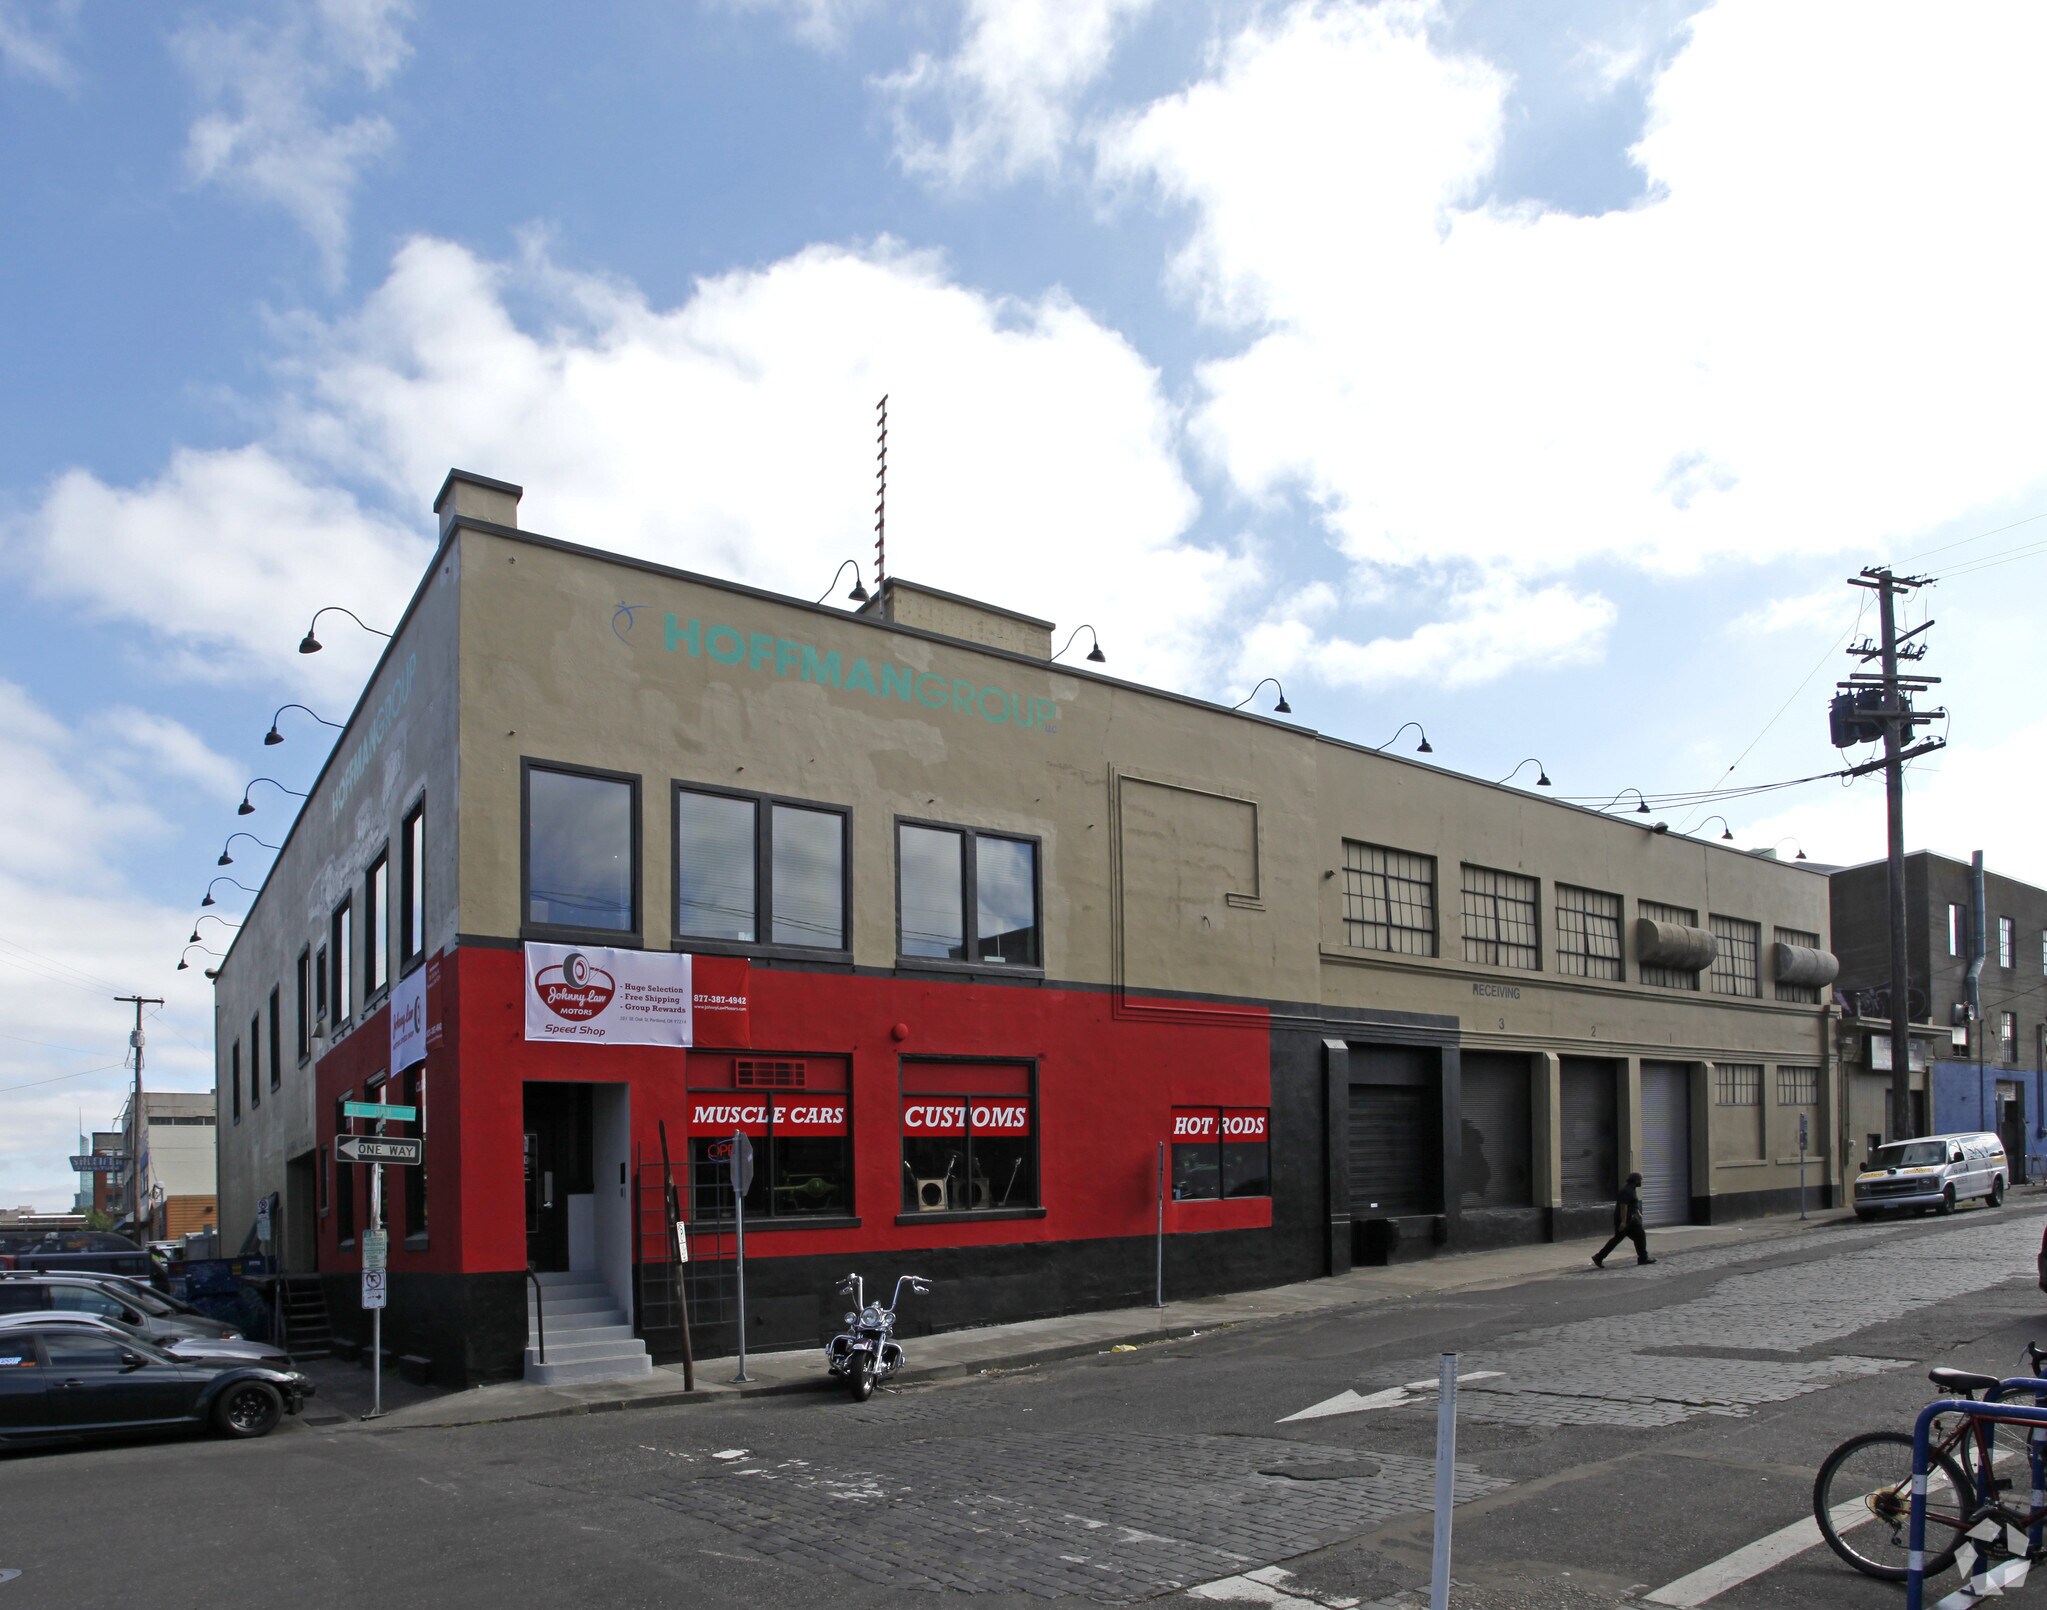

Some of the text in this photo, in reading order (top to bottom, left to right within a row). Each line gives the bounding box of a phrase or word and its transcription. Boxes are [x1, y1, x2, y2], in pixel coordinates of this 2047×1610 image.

[664, 611, 1057, 730] HOFFMANGROUP
[624, 983, 684, 994] Huge Selection
[1472, 983, 1521, 1000] RECEIVING
[548, 986, 607, 1007] Johnny Law
[624, 993, 680, 1005] Free Shipping
[693, 994, 747, 1005] 877-387-4942
[560, 1008, 593, 1016] MOTORS
[624, 1003, 686, 1014] Group Rewards
[1498, 1018, 1505, 1030] 3
[544, 1024, 606, 1037] Speed Shop
[1591, 1025, 1596, 1037] 2
[692, 1106, 844, 1124] MUSCLE CARS
[904, 1105, 1027, 1127] CUSTOMS
[1173, 1117, 1265, 1135] HOT RODS
[358, 1144, 414, 1156] ONE WAY
